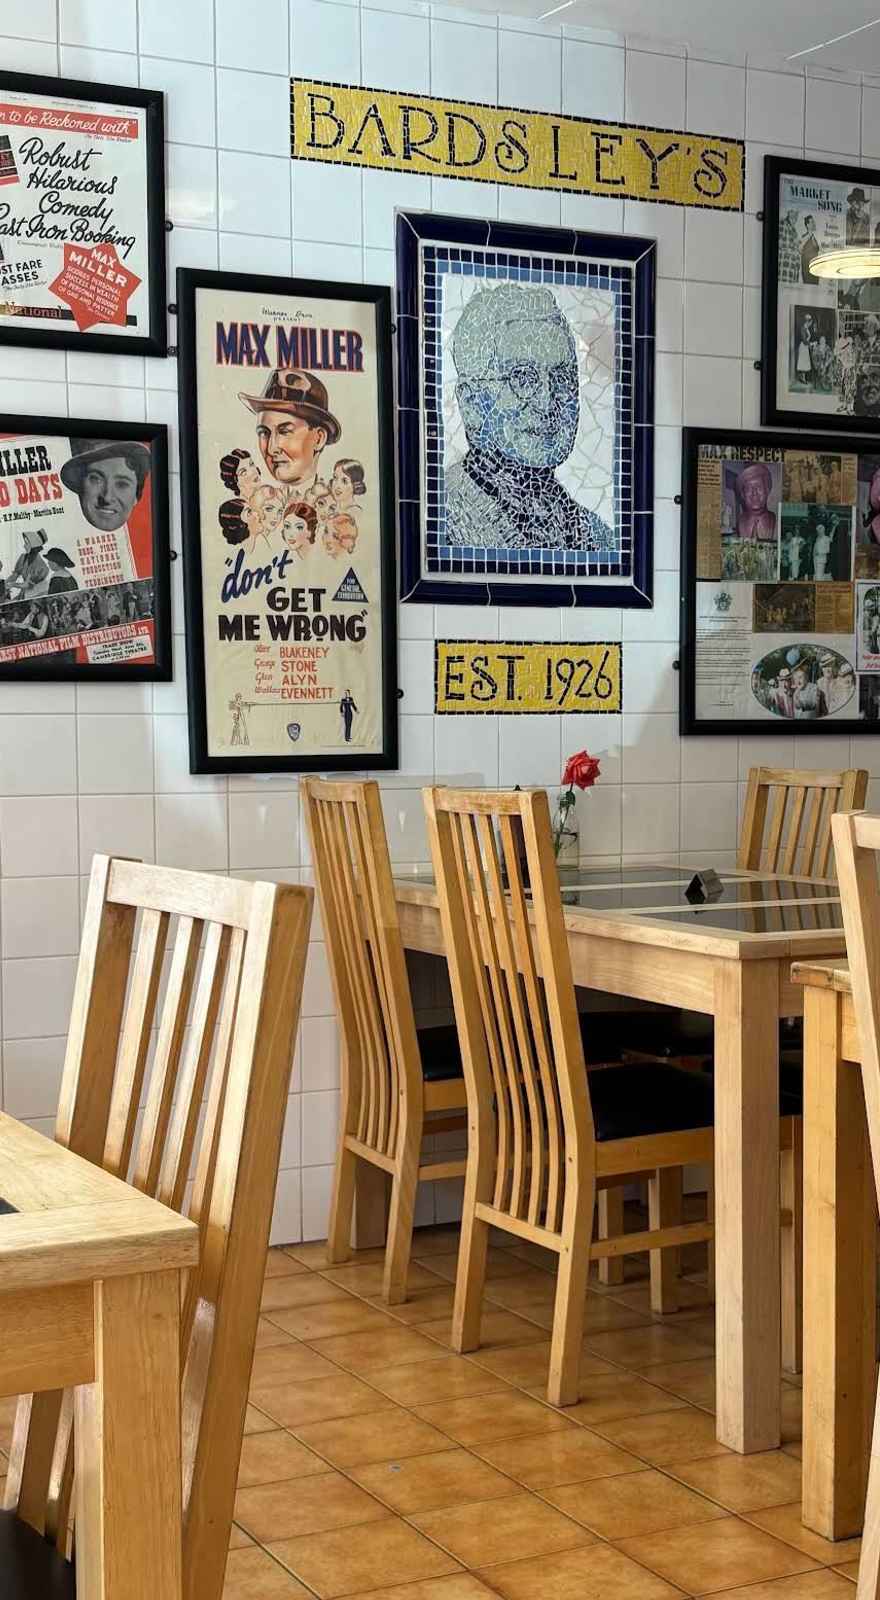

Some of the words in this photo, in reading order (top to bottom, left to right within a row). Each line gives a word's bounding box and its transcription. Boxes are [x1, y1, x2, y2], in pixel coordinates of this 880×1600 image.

[9, 110, 22, 122] to
[24, 110, 39, 124] be
[39, 111, 101, 131] Reckoned
[19, 137, 103, 171] Robust
[306, 93, 728, 198] BARDSLEY'S
[27, 167, 118, 195] Hilarious
[39, 191, 114, 231] Comedy
[26, 213, 68, 240] Iron
[70, 218, 136, 260] Booking
[15, 259, 43, 272] FARE
[69, 251, 128, 288] MILLER
[90, 248, 117, 268] MAX
[216, 321, 271, 368] MAX
[275, 325, 364, 373] MILLER
[14, 473, 63, 505] DAYS
[82, 561, 122, 575] PRODUCTION
[266, 586, 327, 613] GET
[17, 638, 59, 660] NATIONAL
[81, 624, 137, 647] DISTRIBUTORS
[218, 614, 260, 643] ME
[280, 646, 330, 659] BLAKENEY
[281, 660, 318, 672] STONE
[282, 674, 317, 686] ALYN
[544, 650, 613, 705] 1926
[281, 687, 334, 699] EVENNETT
